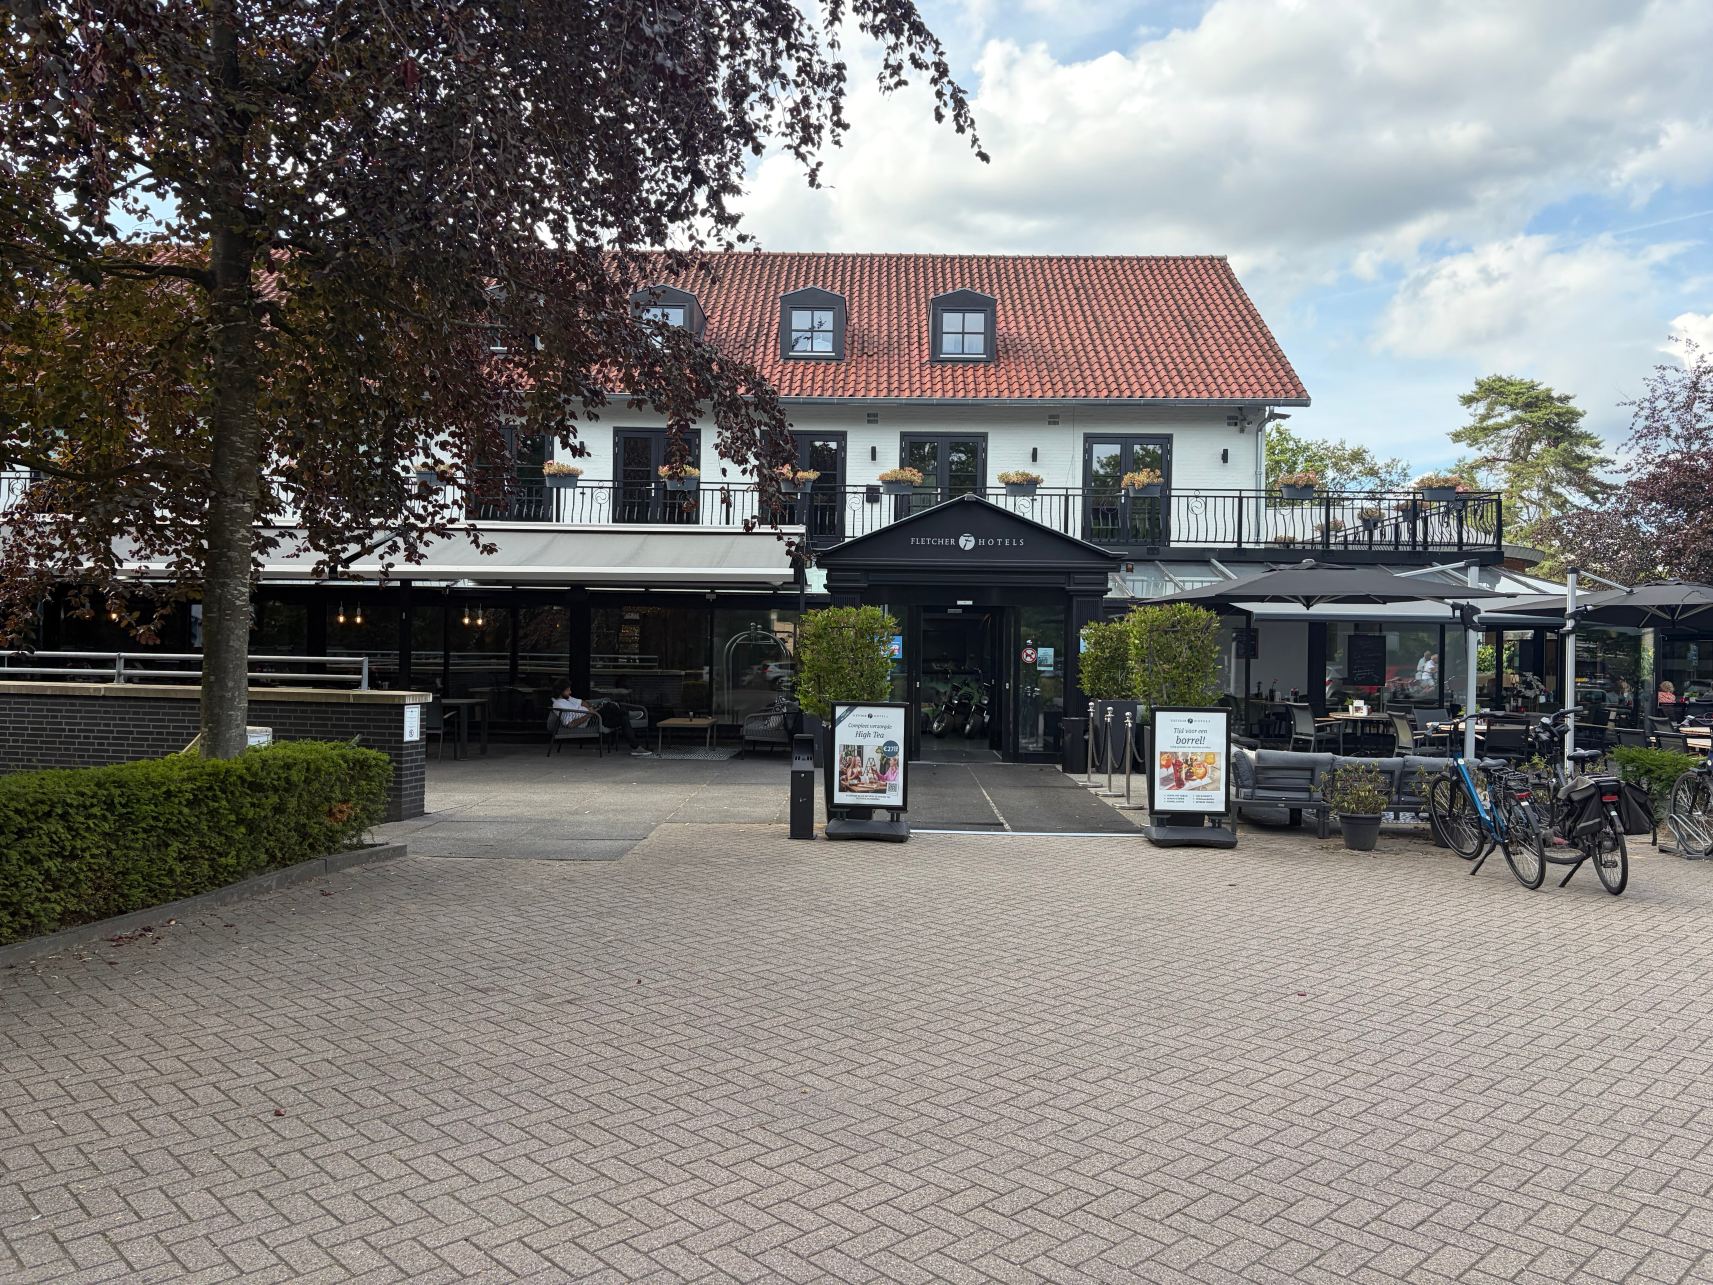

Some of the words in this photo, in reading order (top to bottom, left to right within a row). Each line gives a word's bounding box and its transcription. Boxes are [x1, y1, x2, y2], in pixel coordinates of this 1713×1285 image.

[910, 537, 956, 546] FLETCHER
[978, 538, 1025, 546] HOTELS
[855, 730, 871, 740] High
[873, 731, 885, 739] Tea
[1175, 735, 1206, 745] borrel!
